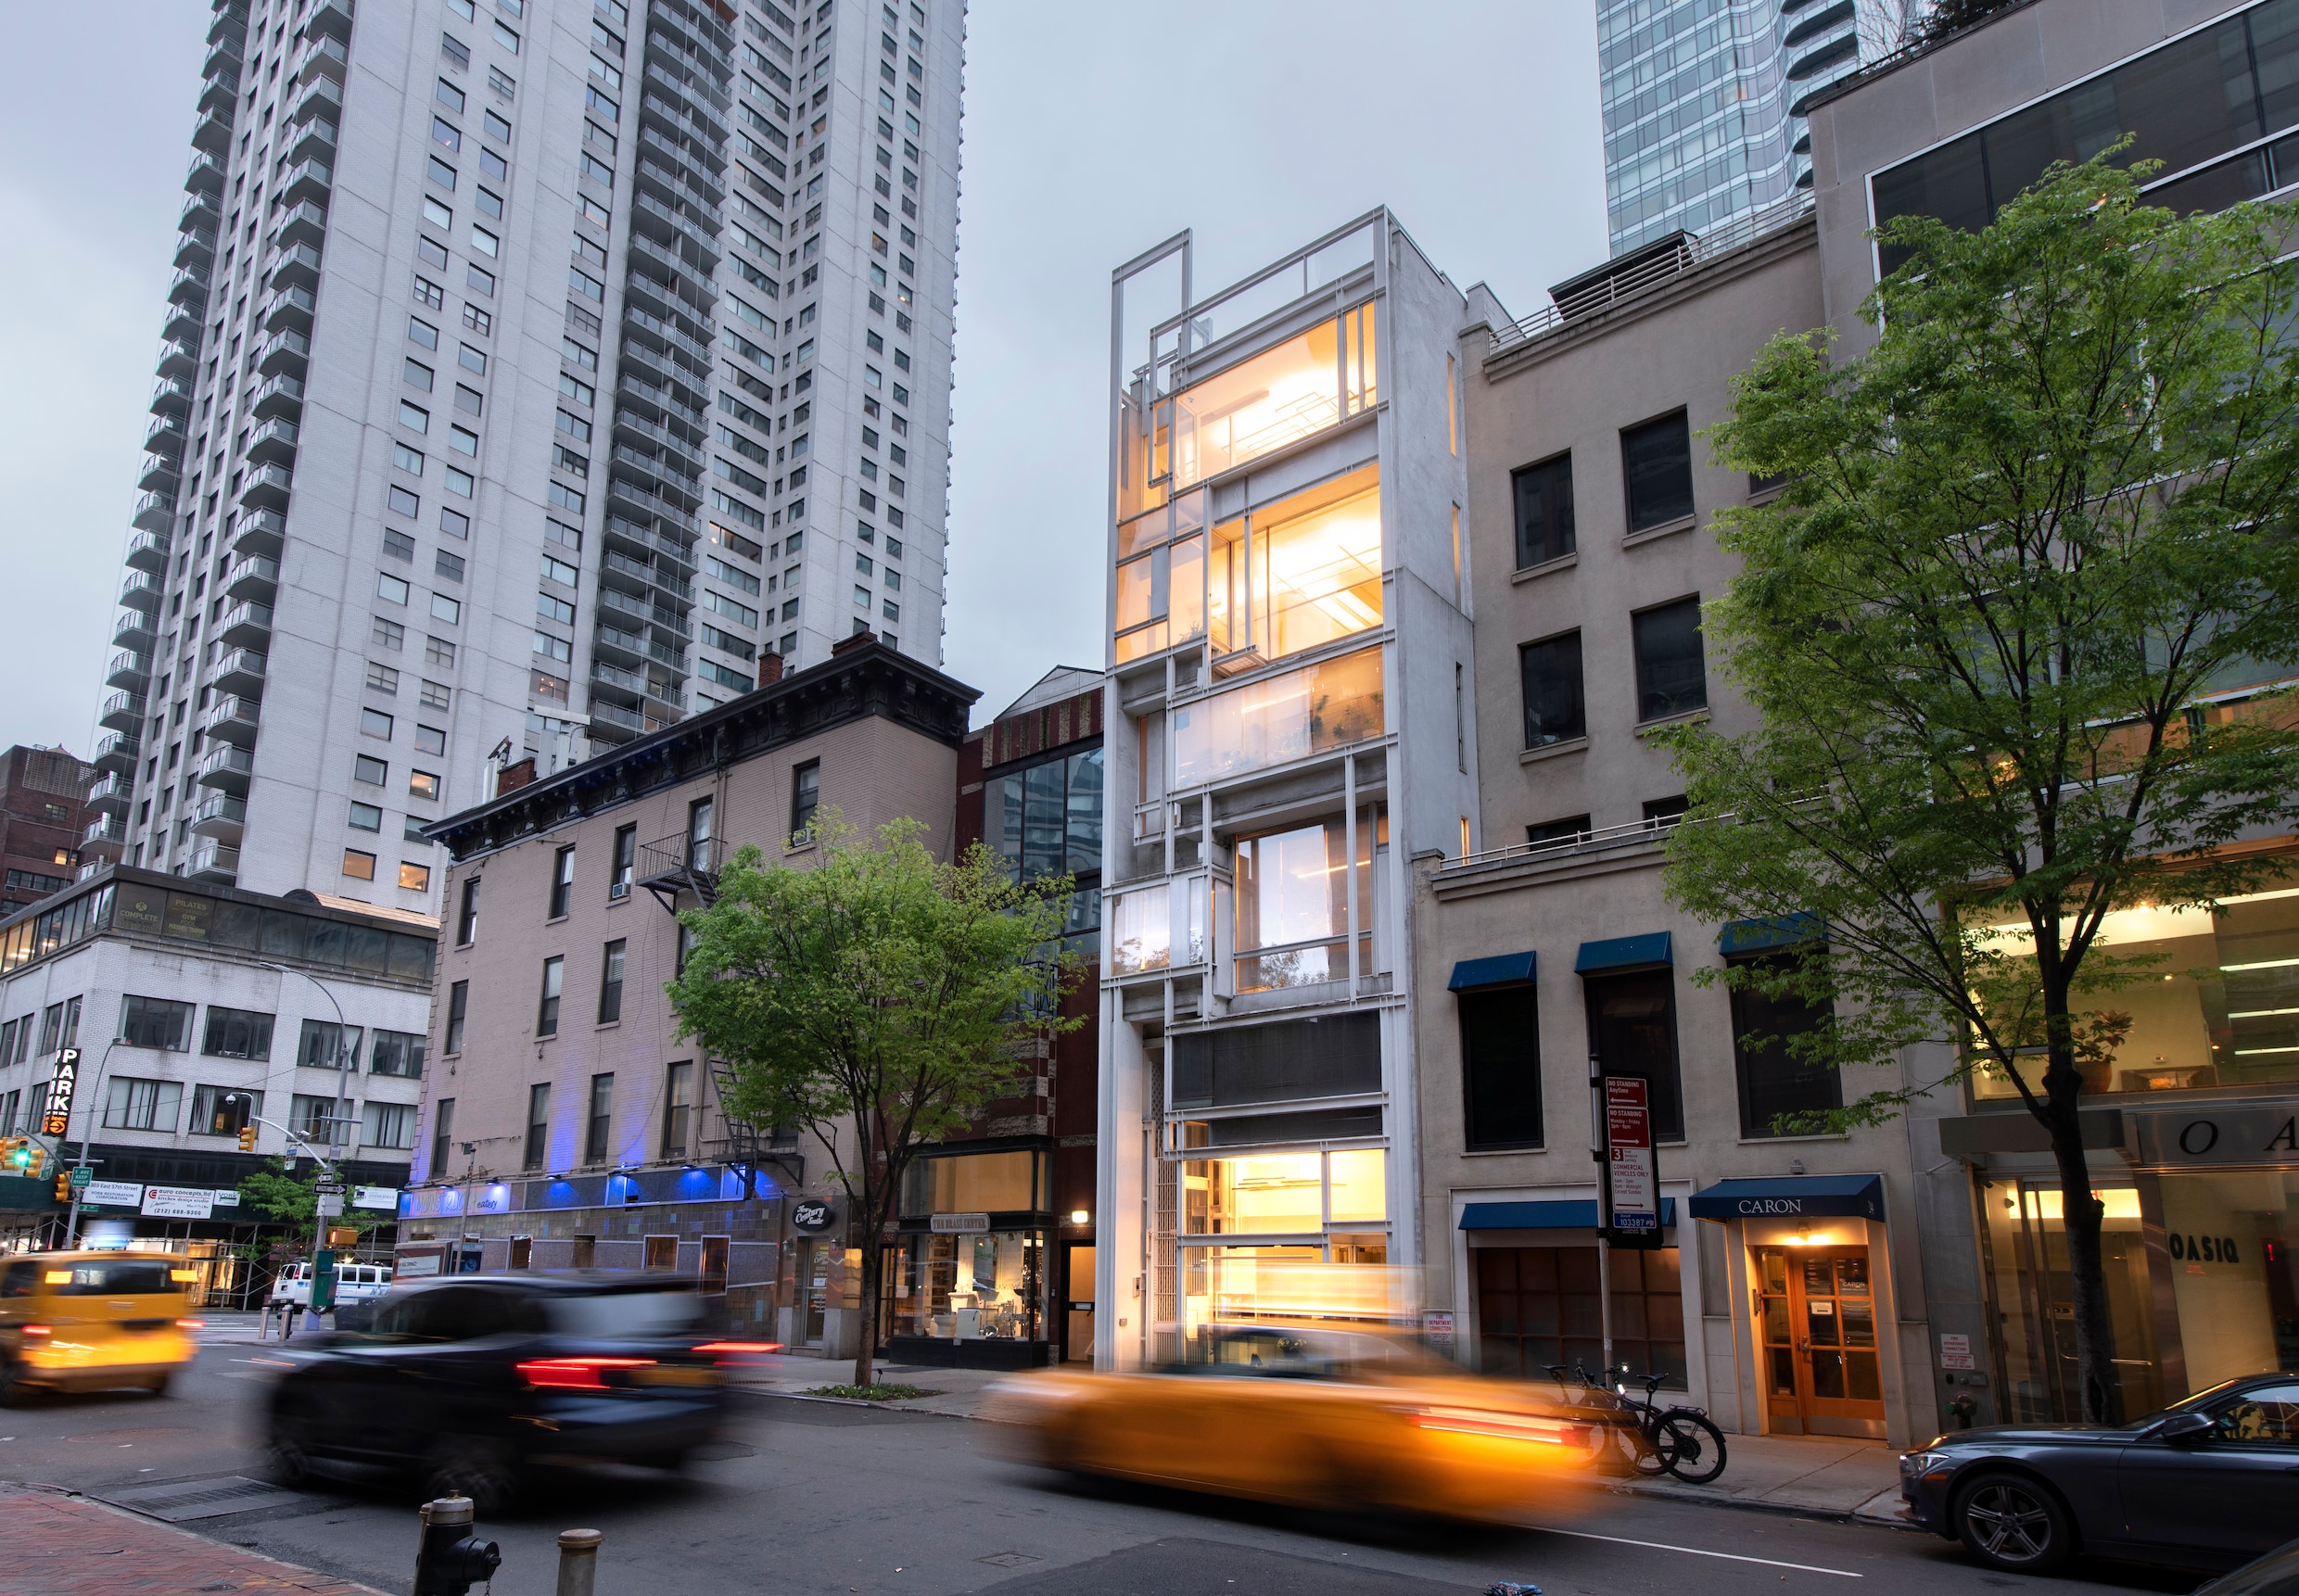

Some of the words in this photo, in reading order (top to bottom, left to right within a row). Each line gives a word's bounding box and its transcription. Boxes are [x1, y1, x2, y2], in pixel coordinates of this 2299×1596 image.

[175, 899, 207, 910] PILATES
[120, 909, 159, 922] COMPLETE
[53, 1048, 78, 1111] PARK
[1614, 1149, 1620, 1160] 3
[476, 1199, 497, 1210] eatery
[797, 1205, 809, 1213] New
[1738, 1198, 1801, 1214] CARON
[795, 1207, 825, 1224] Century
[934, 1220, 945, 1229] THE
[946, 1219, 963, 1229] BRASS
[964, 1219, 986, 1229] CENTER
[2169, 1233, 2240, 1262] OASIQ
